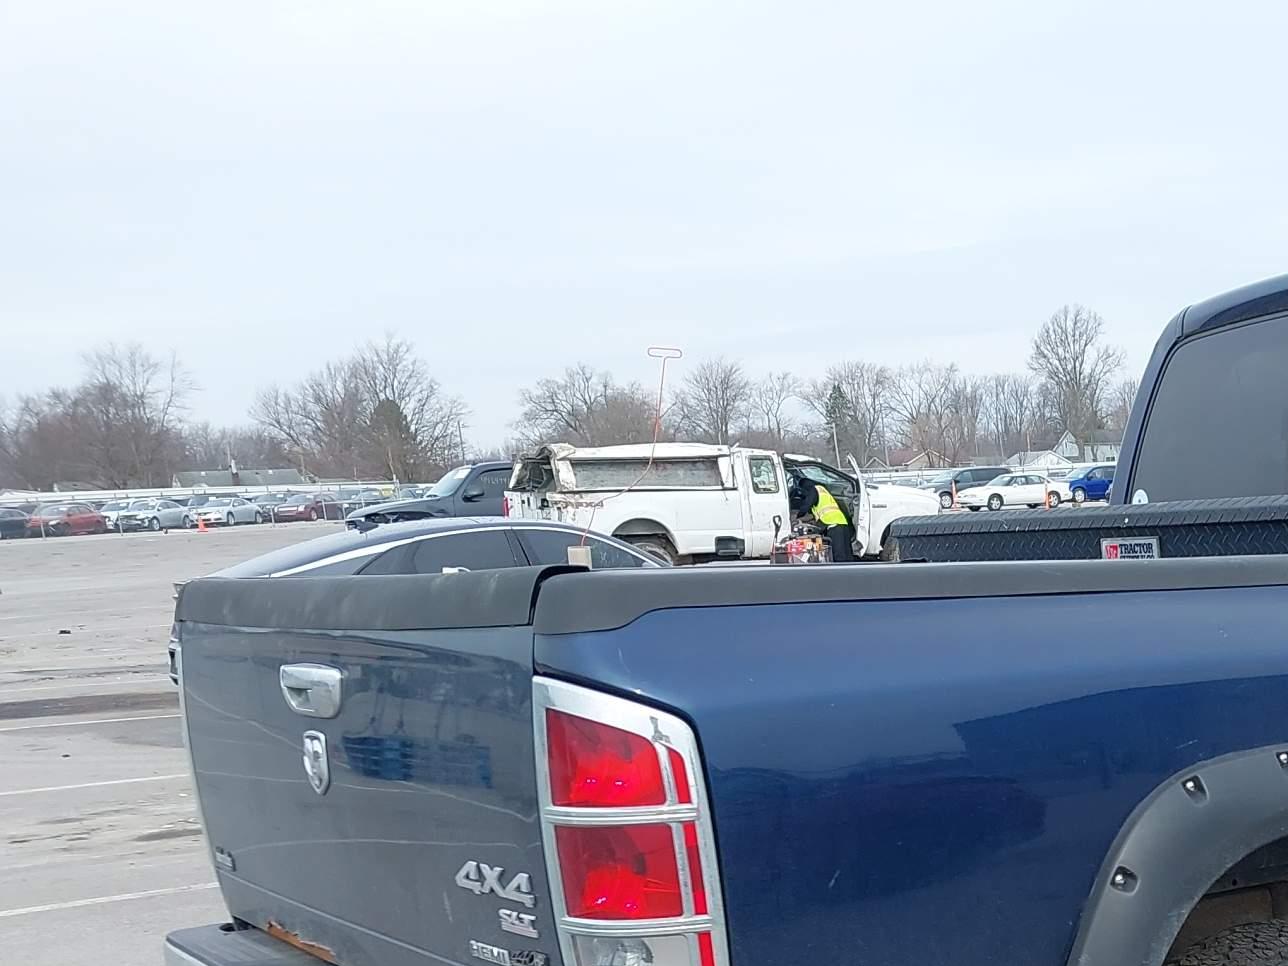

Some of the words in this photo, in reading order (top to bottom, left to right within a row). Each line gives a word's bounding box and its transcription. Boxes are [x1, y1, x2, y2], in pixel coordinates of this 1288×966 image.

[1119, 543, 1153, 555] TRACTOR
[455, 860, 538, 909] 4X4
[498, 908, 538, 934] SLT
